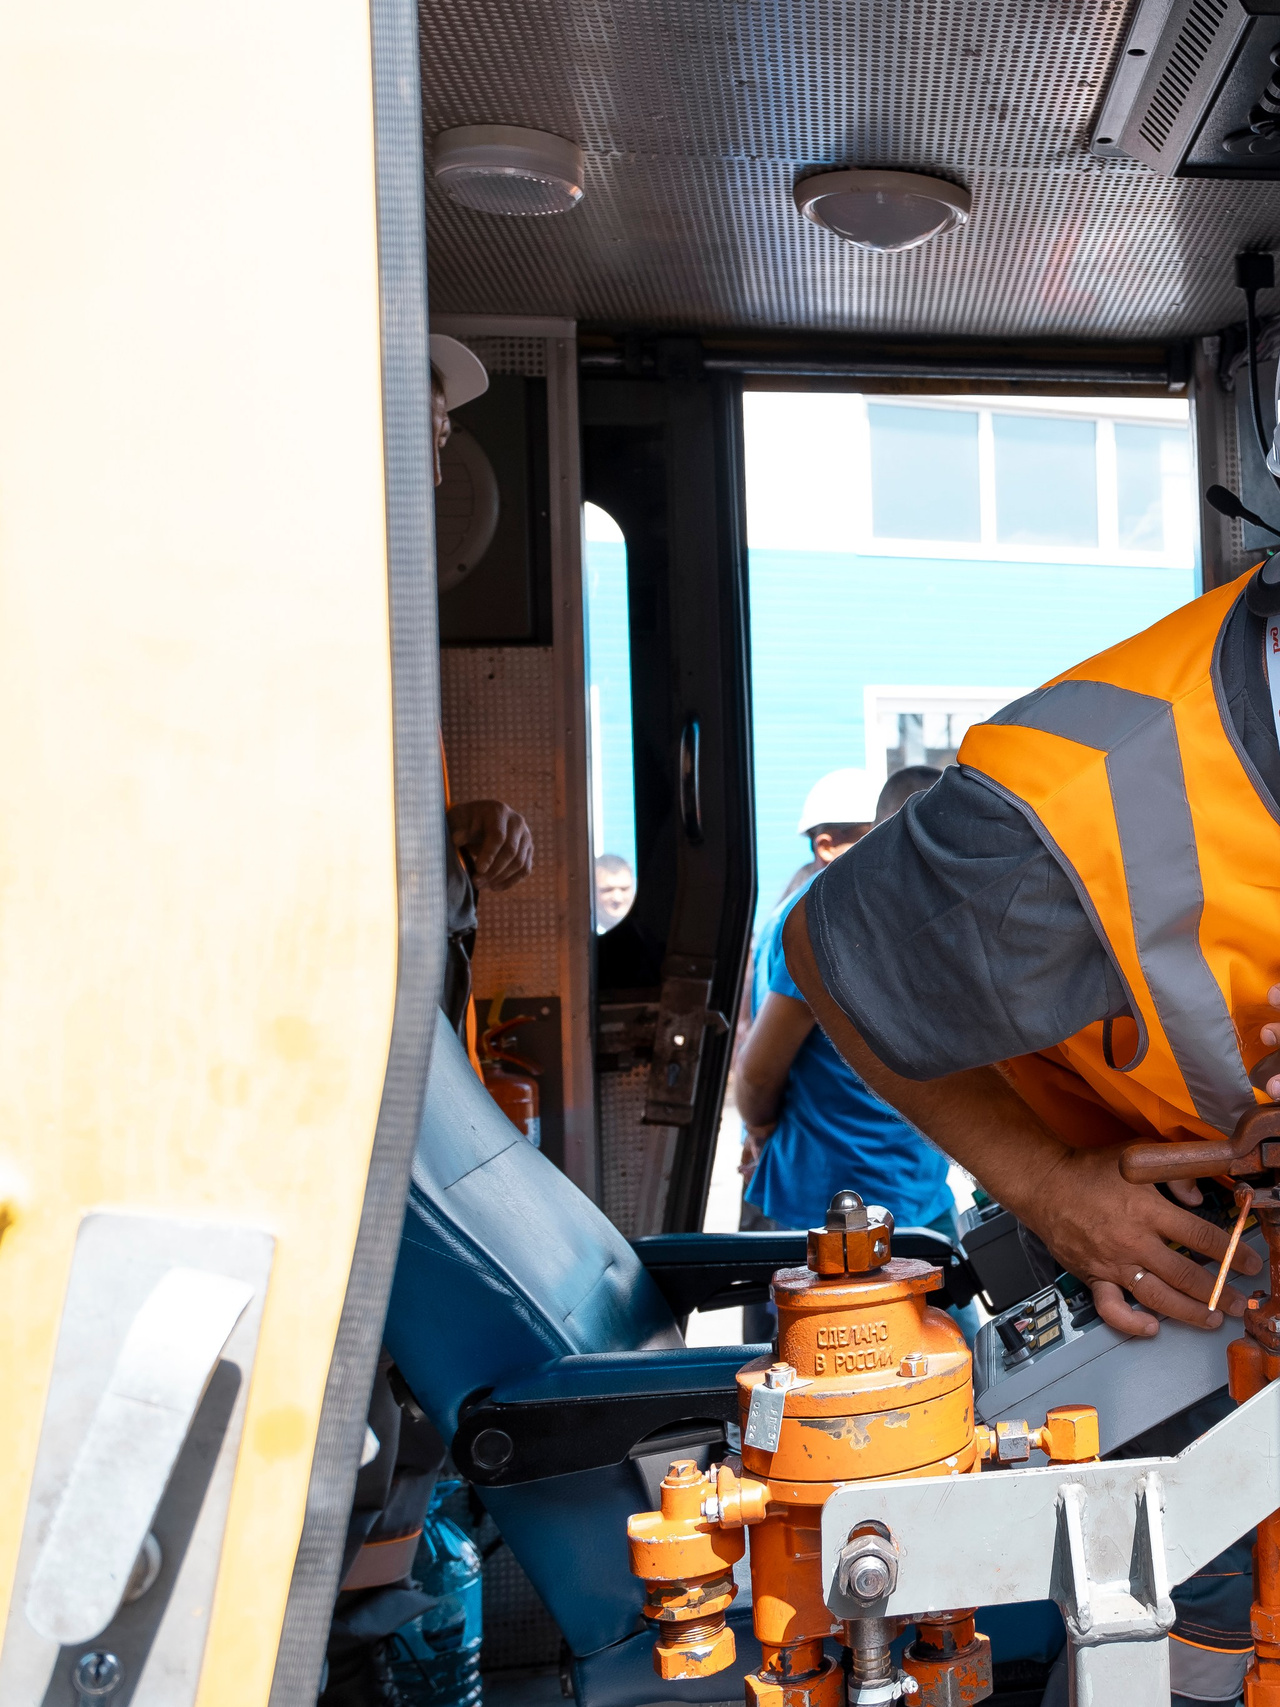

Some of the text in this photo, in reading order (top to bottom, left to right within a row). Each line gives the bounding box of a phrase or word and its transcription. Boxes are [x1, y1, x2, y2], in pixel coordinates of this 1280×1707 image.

[817, 1321, 889, 1350] СДЕЛАНО
[814, 1344, 894, 1376] В РОССИИ
